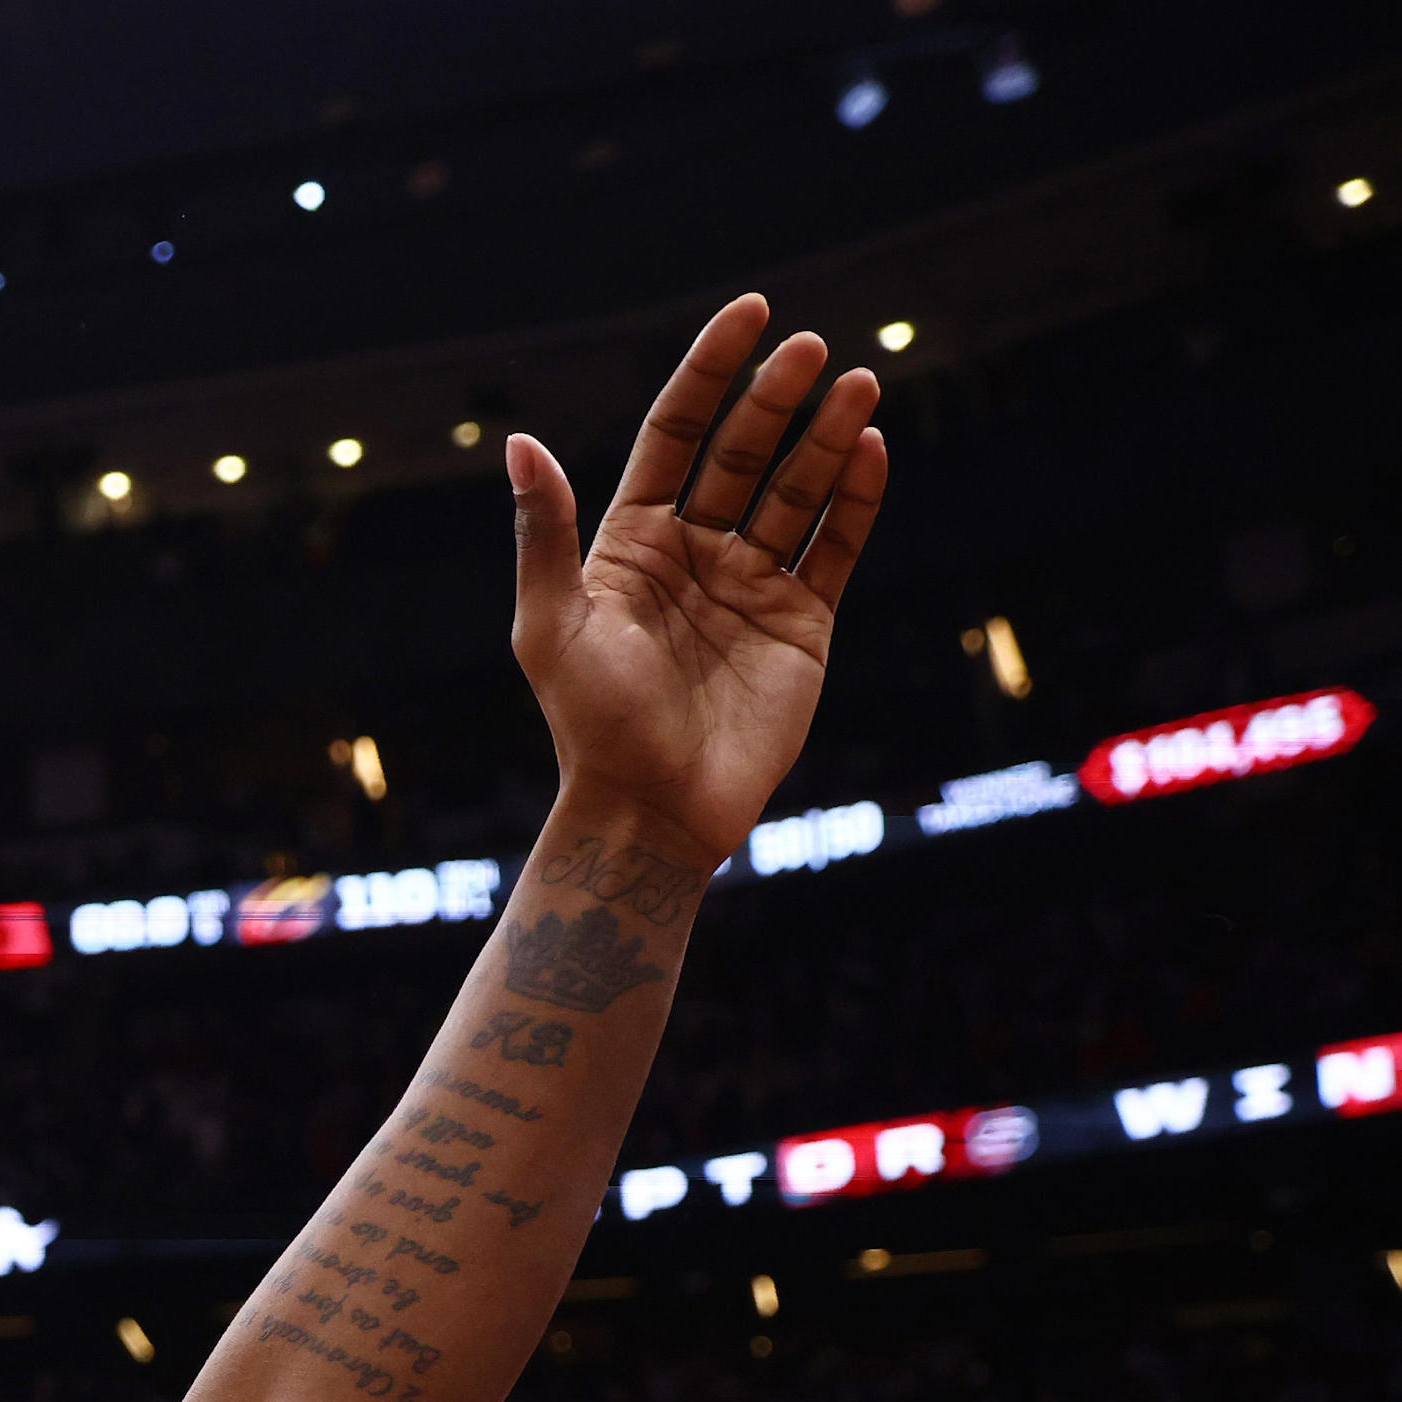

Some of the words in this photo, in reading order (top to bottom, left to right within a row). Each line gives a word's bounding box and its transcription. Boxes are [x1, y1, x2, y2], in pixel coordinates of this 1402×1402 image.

[420, 1114, 495, 1151] will
[395, 1149, 482, 1188] your
[595, 1104, 1039, 1222] PTORS
[389, 1189, 461, 1224] give
[350, 1222, 387, 1247] do
[387, 1237, 459, 1274] and
[297, 1288, 350, 1324] for
[381, 1279, 420, 1310] be
[352, 1308, 380, 1334] as
[378, 1328, 441, 1374] But
